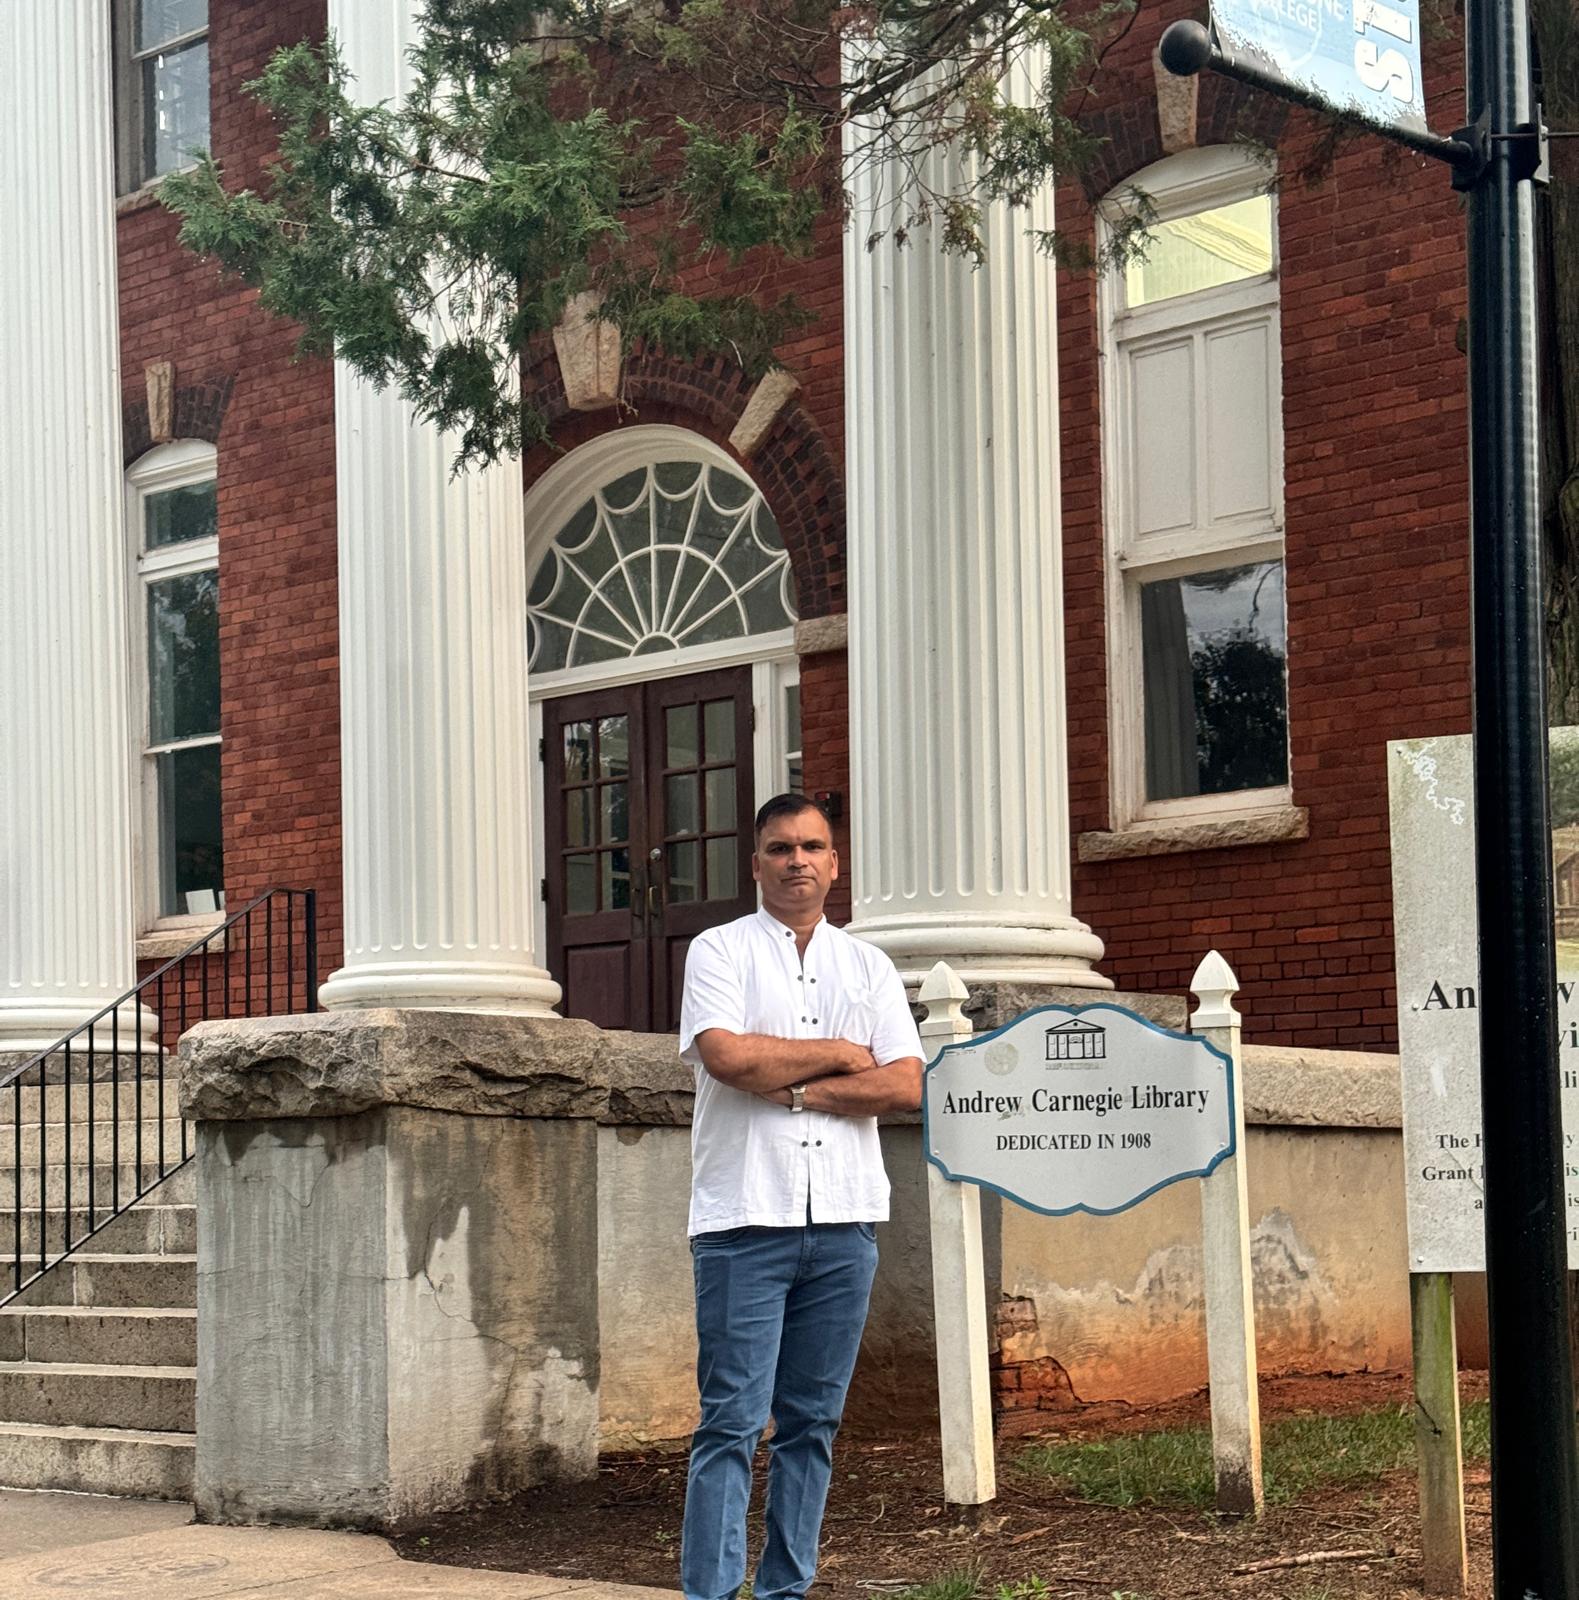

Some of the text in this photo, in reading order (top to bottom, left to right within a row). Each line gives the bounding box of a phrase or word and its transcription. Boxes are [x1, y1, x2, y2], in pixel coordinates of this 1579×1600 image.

[942, 1084, 1210, 1117] Andrew Carnegie Library
[996, 1132, 1152, 1151] DEDICATED IN 1908
[1435, 1133, 1470, 1149] The
[1421, 1165, 1474, 1181] Grant
